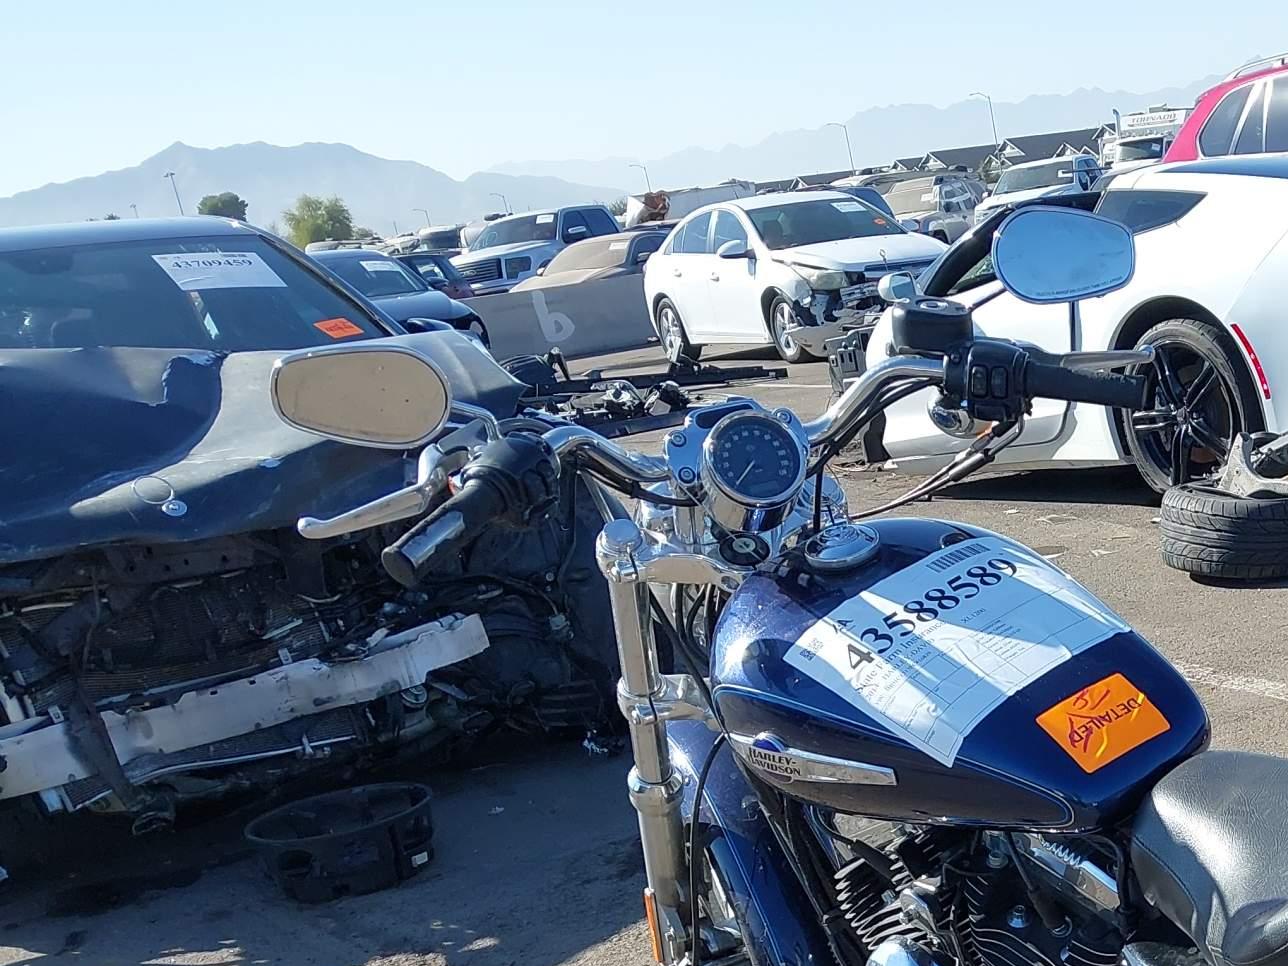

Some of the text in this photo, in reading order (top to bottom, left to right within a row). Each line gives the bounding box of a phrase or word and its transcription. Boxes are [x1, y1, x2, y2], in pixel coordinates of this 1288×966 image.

[847, 558, 1018, 670] 43588589
[1069, 697, 1141, 744] DETAILED
[751, 749, 796, 766] HARLEY-
